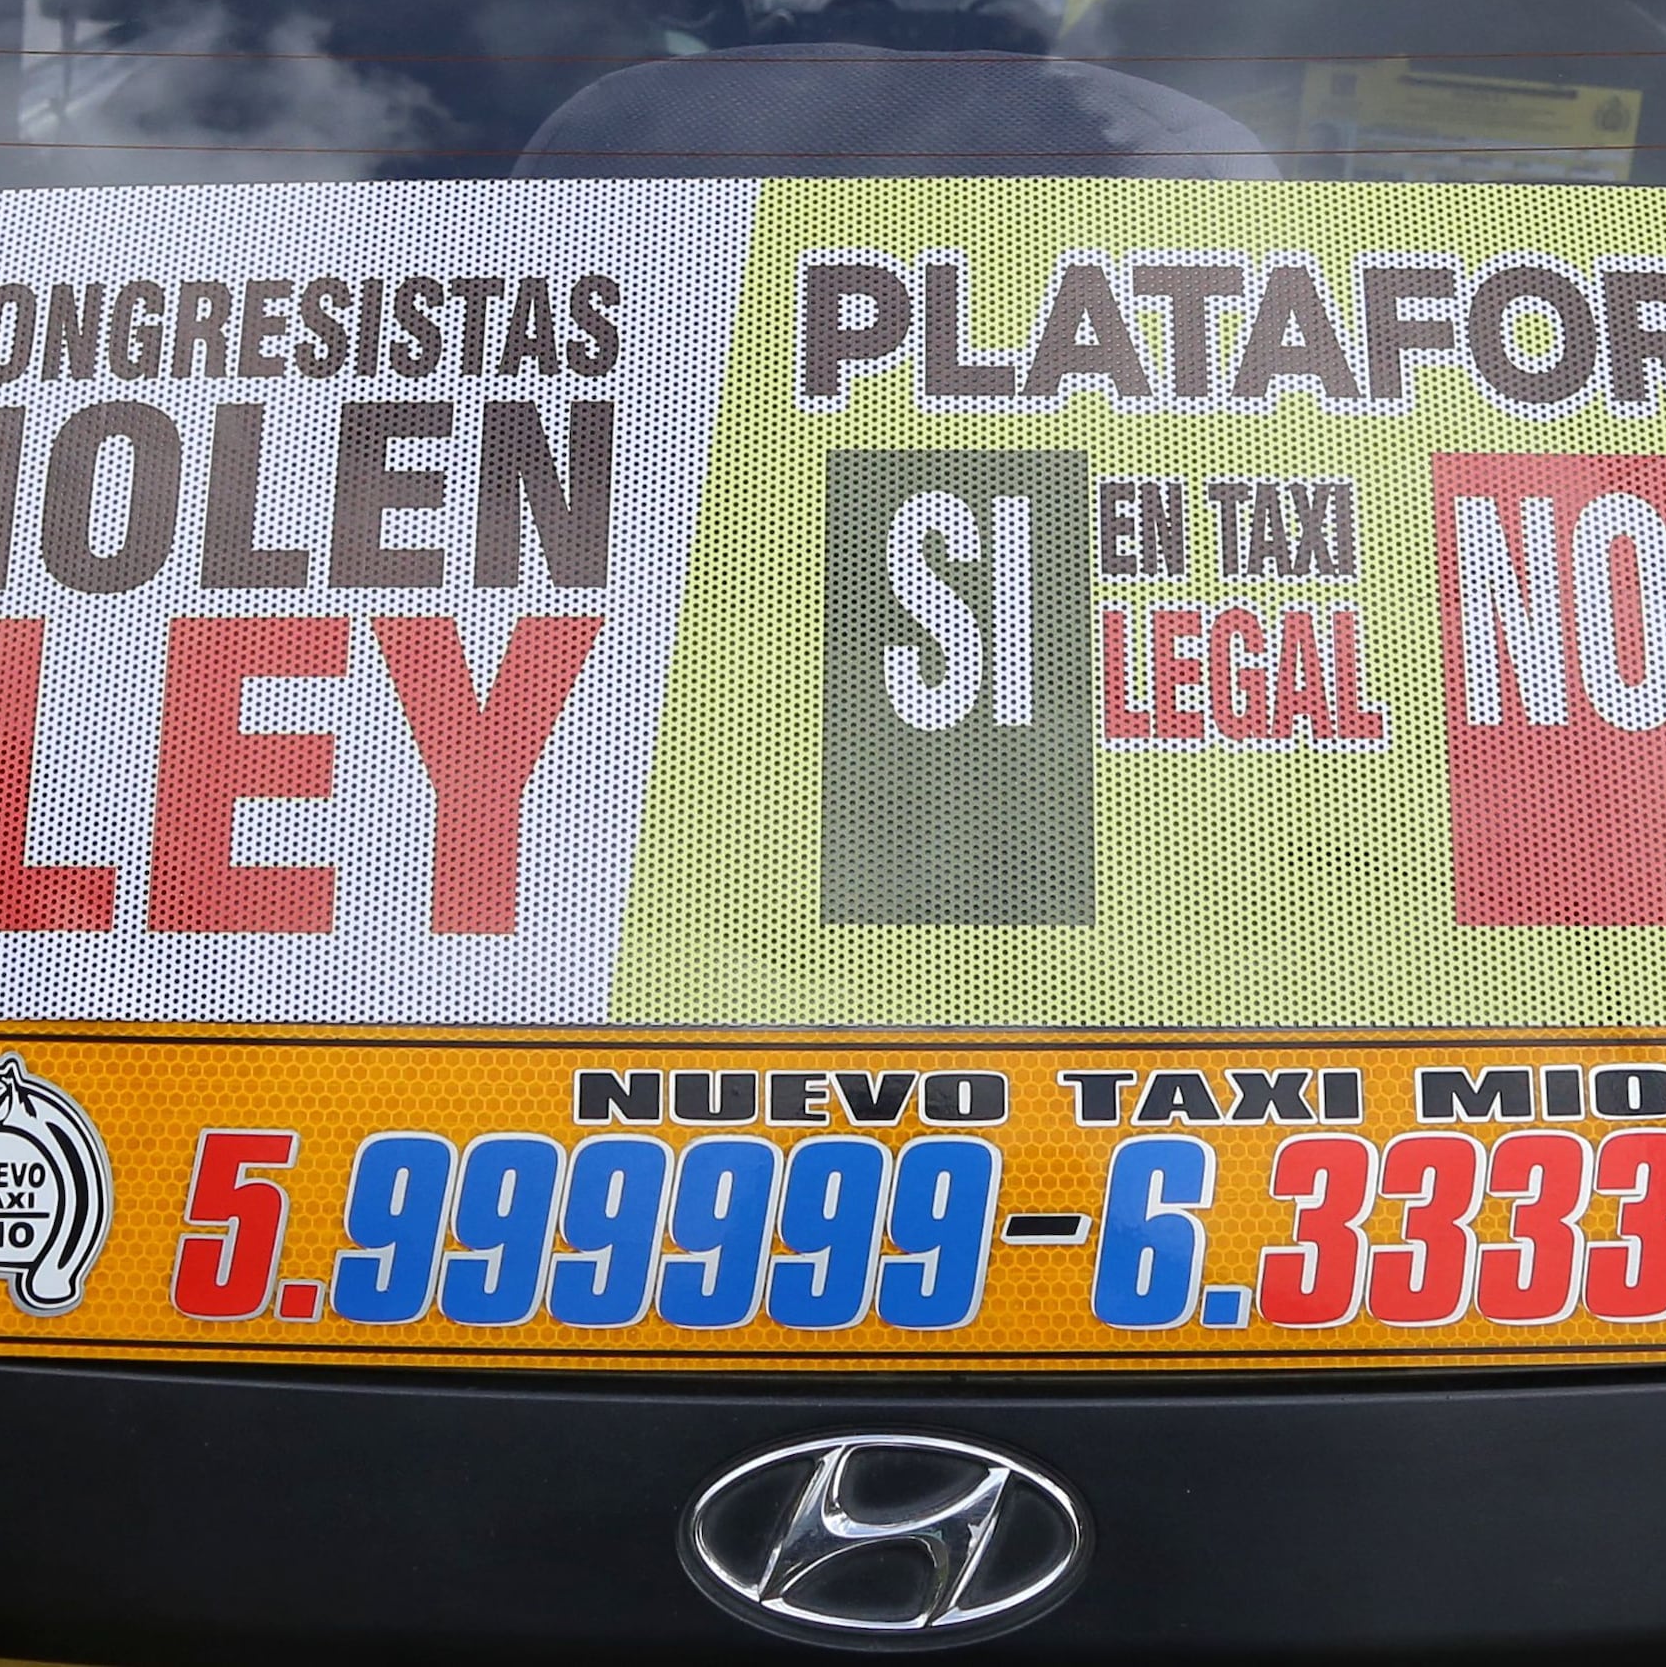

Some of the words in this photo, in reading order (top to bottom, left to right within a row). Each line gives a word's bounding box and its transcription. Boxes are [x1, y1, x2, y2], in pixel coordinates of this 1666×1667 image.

[1099, 482, 1181, 579] EN
[1207, 480, 1357, 580] TAXI
[882, 491, 1035, 731] SI
[1101, 604, 1387, 743] LEGAL
[574, 1067, 1009, 1127] NUEVO
[1060, 1067, 1364, 1125] TAXI
